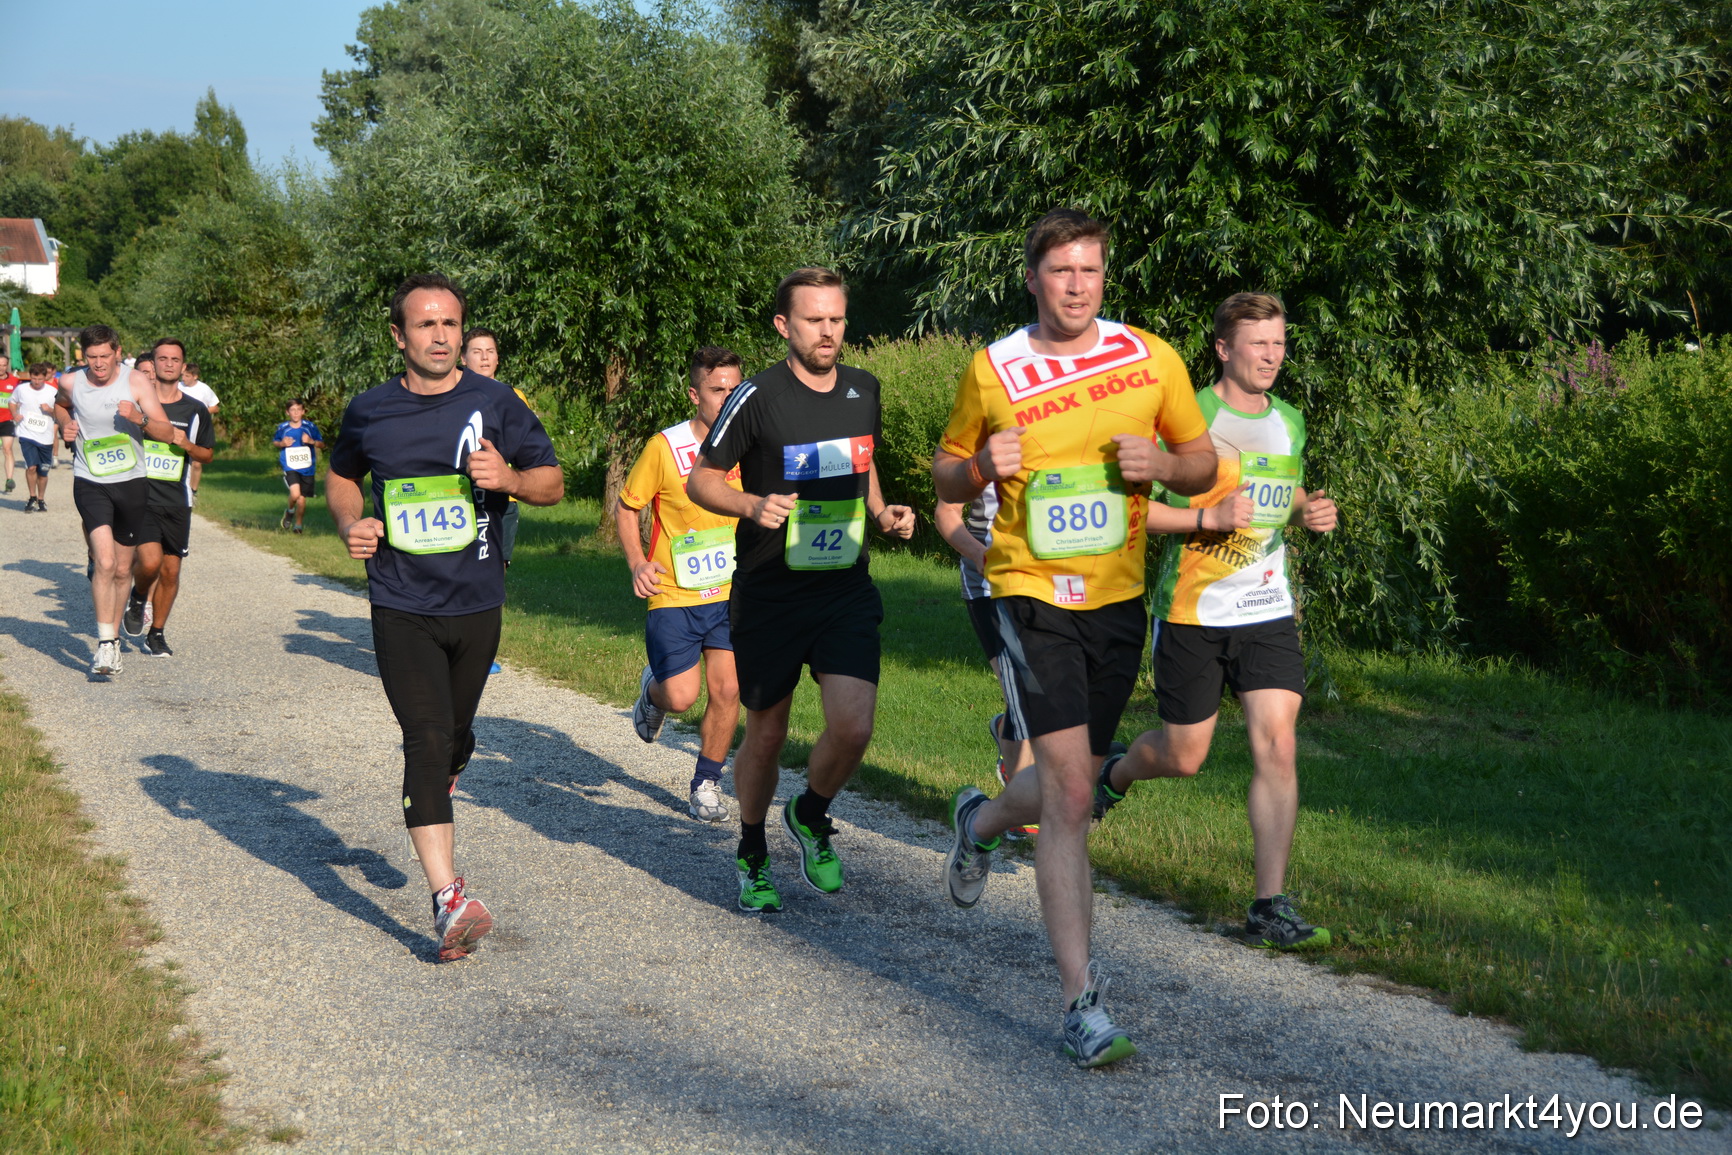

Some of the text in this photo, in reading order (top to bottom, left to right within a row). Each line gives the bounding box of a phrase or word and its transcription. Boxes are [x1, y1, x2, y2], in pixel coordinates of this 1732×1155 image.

[1014, 368, 1159, 428] MAX BÖGL
[28, 418, 46, 427] 8930
[97, 449, 126, 465] 356
[145, 455, 179, 471] 1067
[820, 461, 850, 473] MÜLLER
[1245, 483, 1292, 508] 1003
[397, 505, 467, 534] 1143
[1048, 500, 1107, 533] 880
[811, 529, 843, 551] 42
[687, 550, 727, 575] 916
